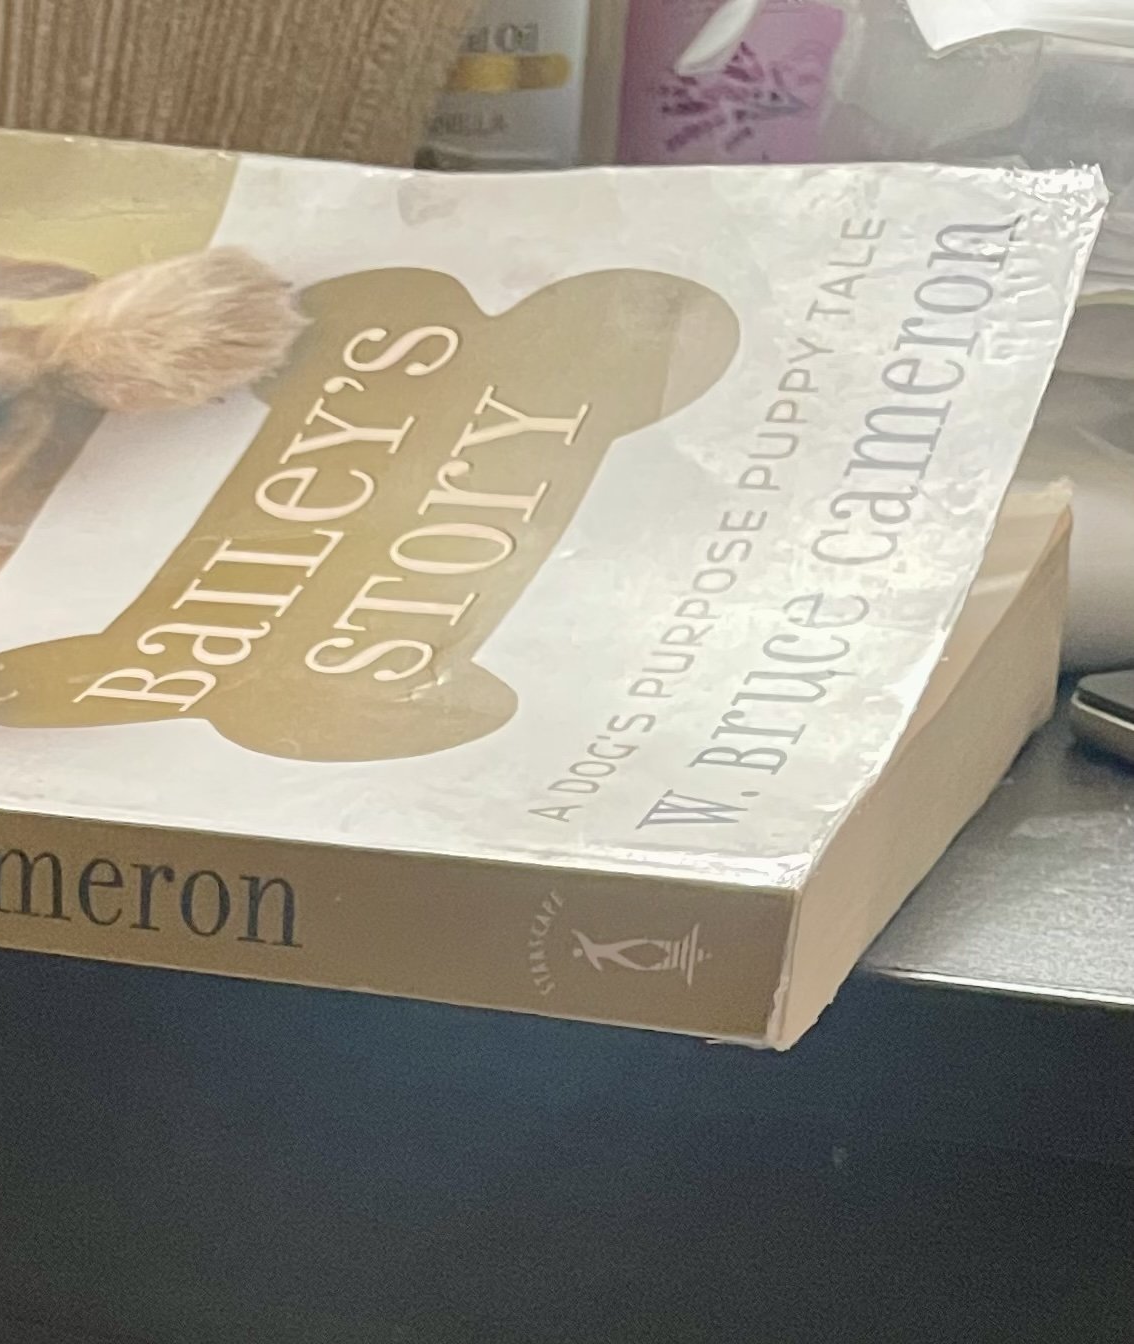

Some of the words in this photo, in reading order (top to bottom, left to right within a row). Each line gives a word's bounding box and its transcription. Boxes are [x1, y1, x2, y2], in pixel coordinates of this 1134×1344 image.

[806, 218, 886, 323] TALE
[739, 338, 834, 492] PUPPY
[628, 510, 767, 700] PURPOSE
[548, 711, 657, 796] DOG'S
[528, 806, 572, 823] A
[636, 788, 760, 831] W.
